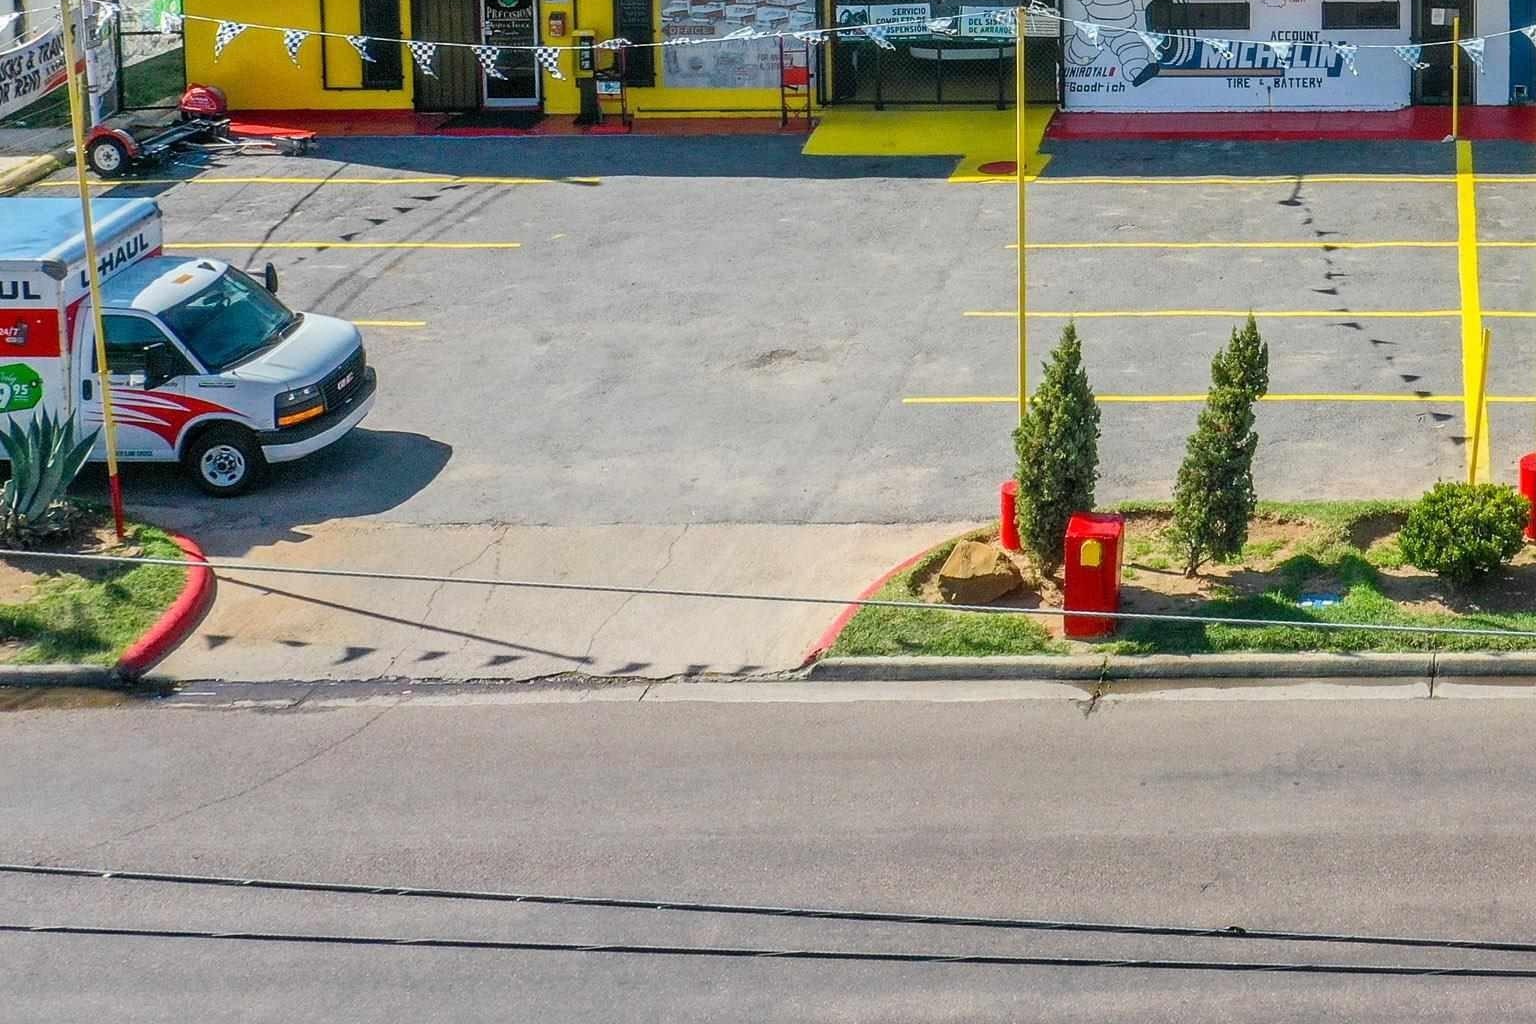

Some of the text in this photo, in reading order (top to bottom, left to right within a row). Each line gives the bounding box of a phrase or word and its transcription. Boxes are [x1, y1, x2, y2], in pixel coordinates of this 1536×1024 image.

[891, 8, 926, 16] SERVICIO
[1271, 31, 1320, 41] ACCOUNT
[1202, 41, 1338, 68] MICHELIN
[1227, 79, 1250, 89] TIRE
[1273, 78, 1323, 89] BATTERY
